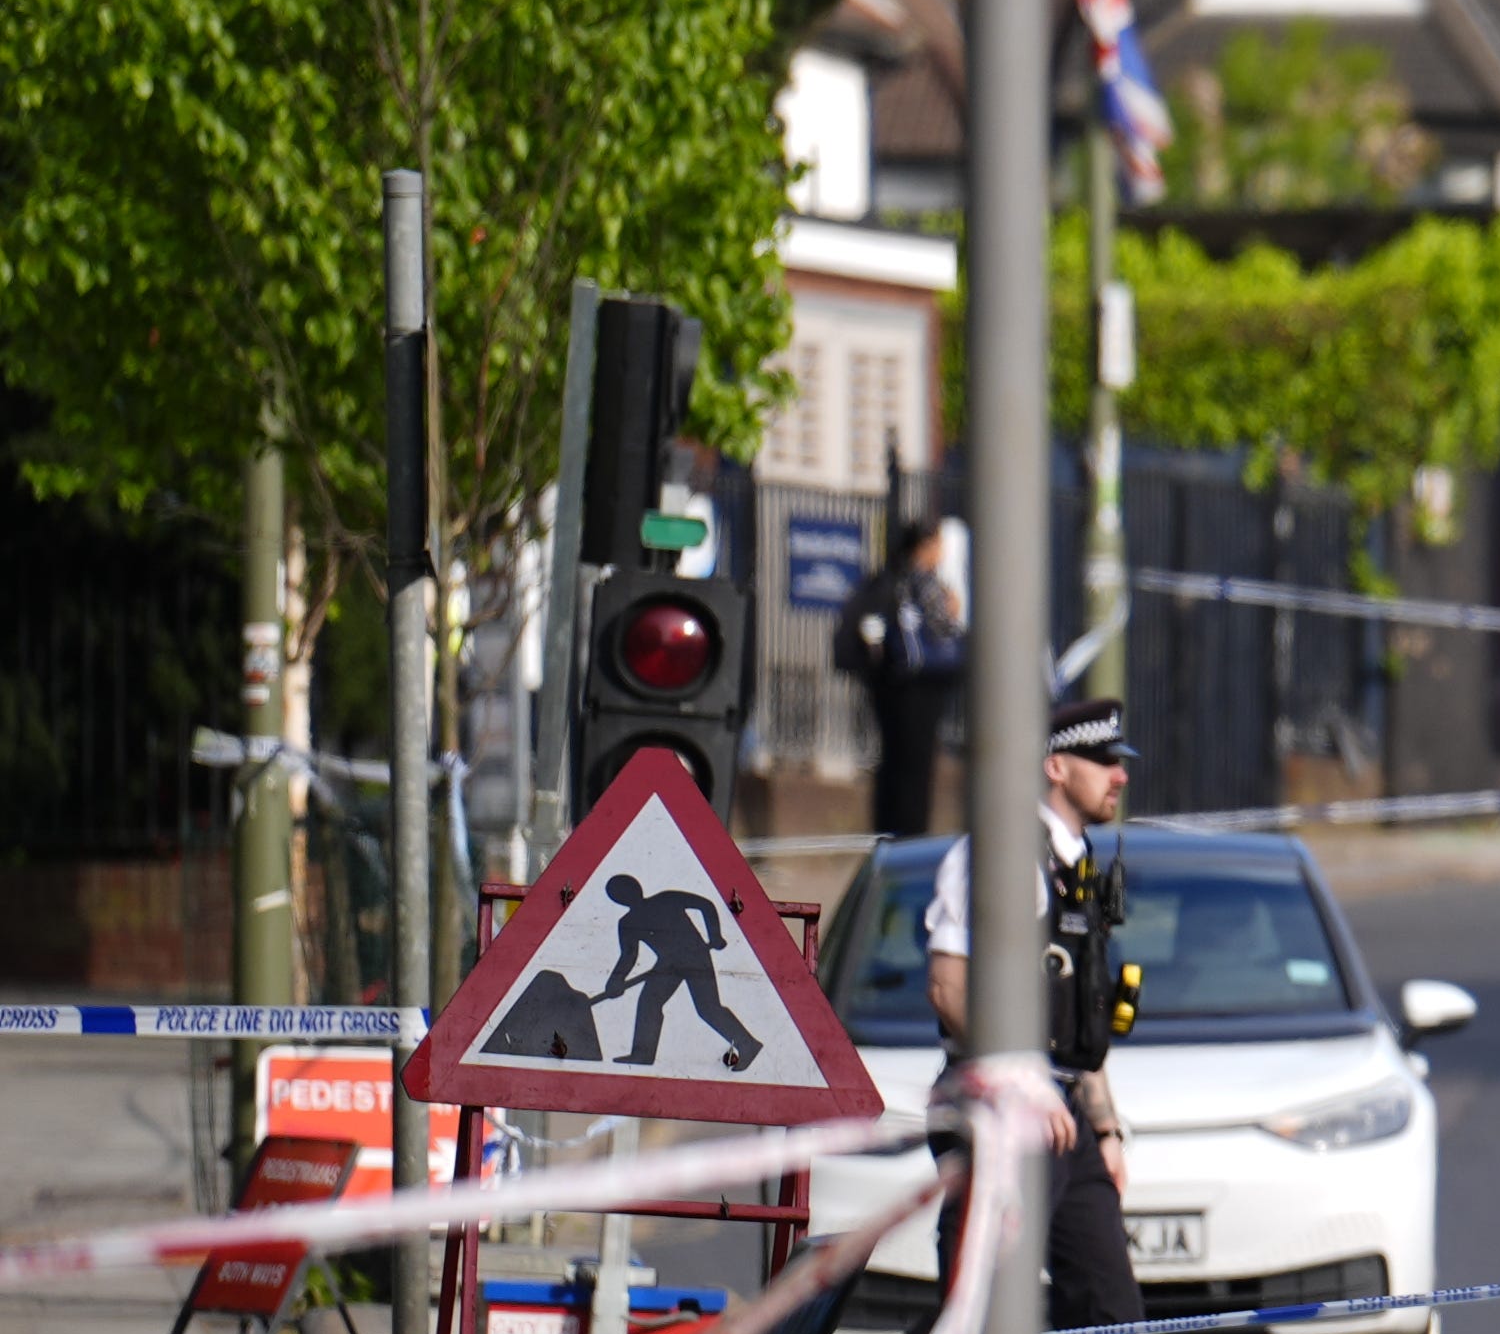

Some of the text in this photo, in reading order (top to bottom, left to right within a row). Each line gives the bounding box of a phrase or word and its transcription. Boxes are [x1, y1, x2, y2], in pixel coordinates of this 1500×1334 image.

[155, 1008, 400, 1035] POLICE LINE DO NOT CROSS
